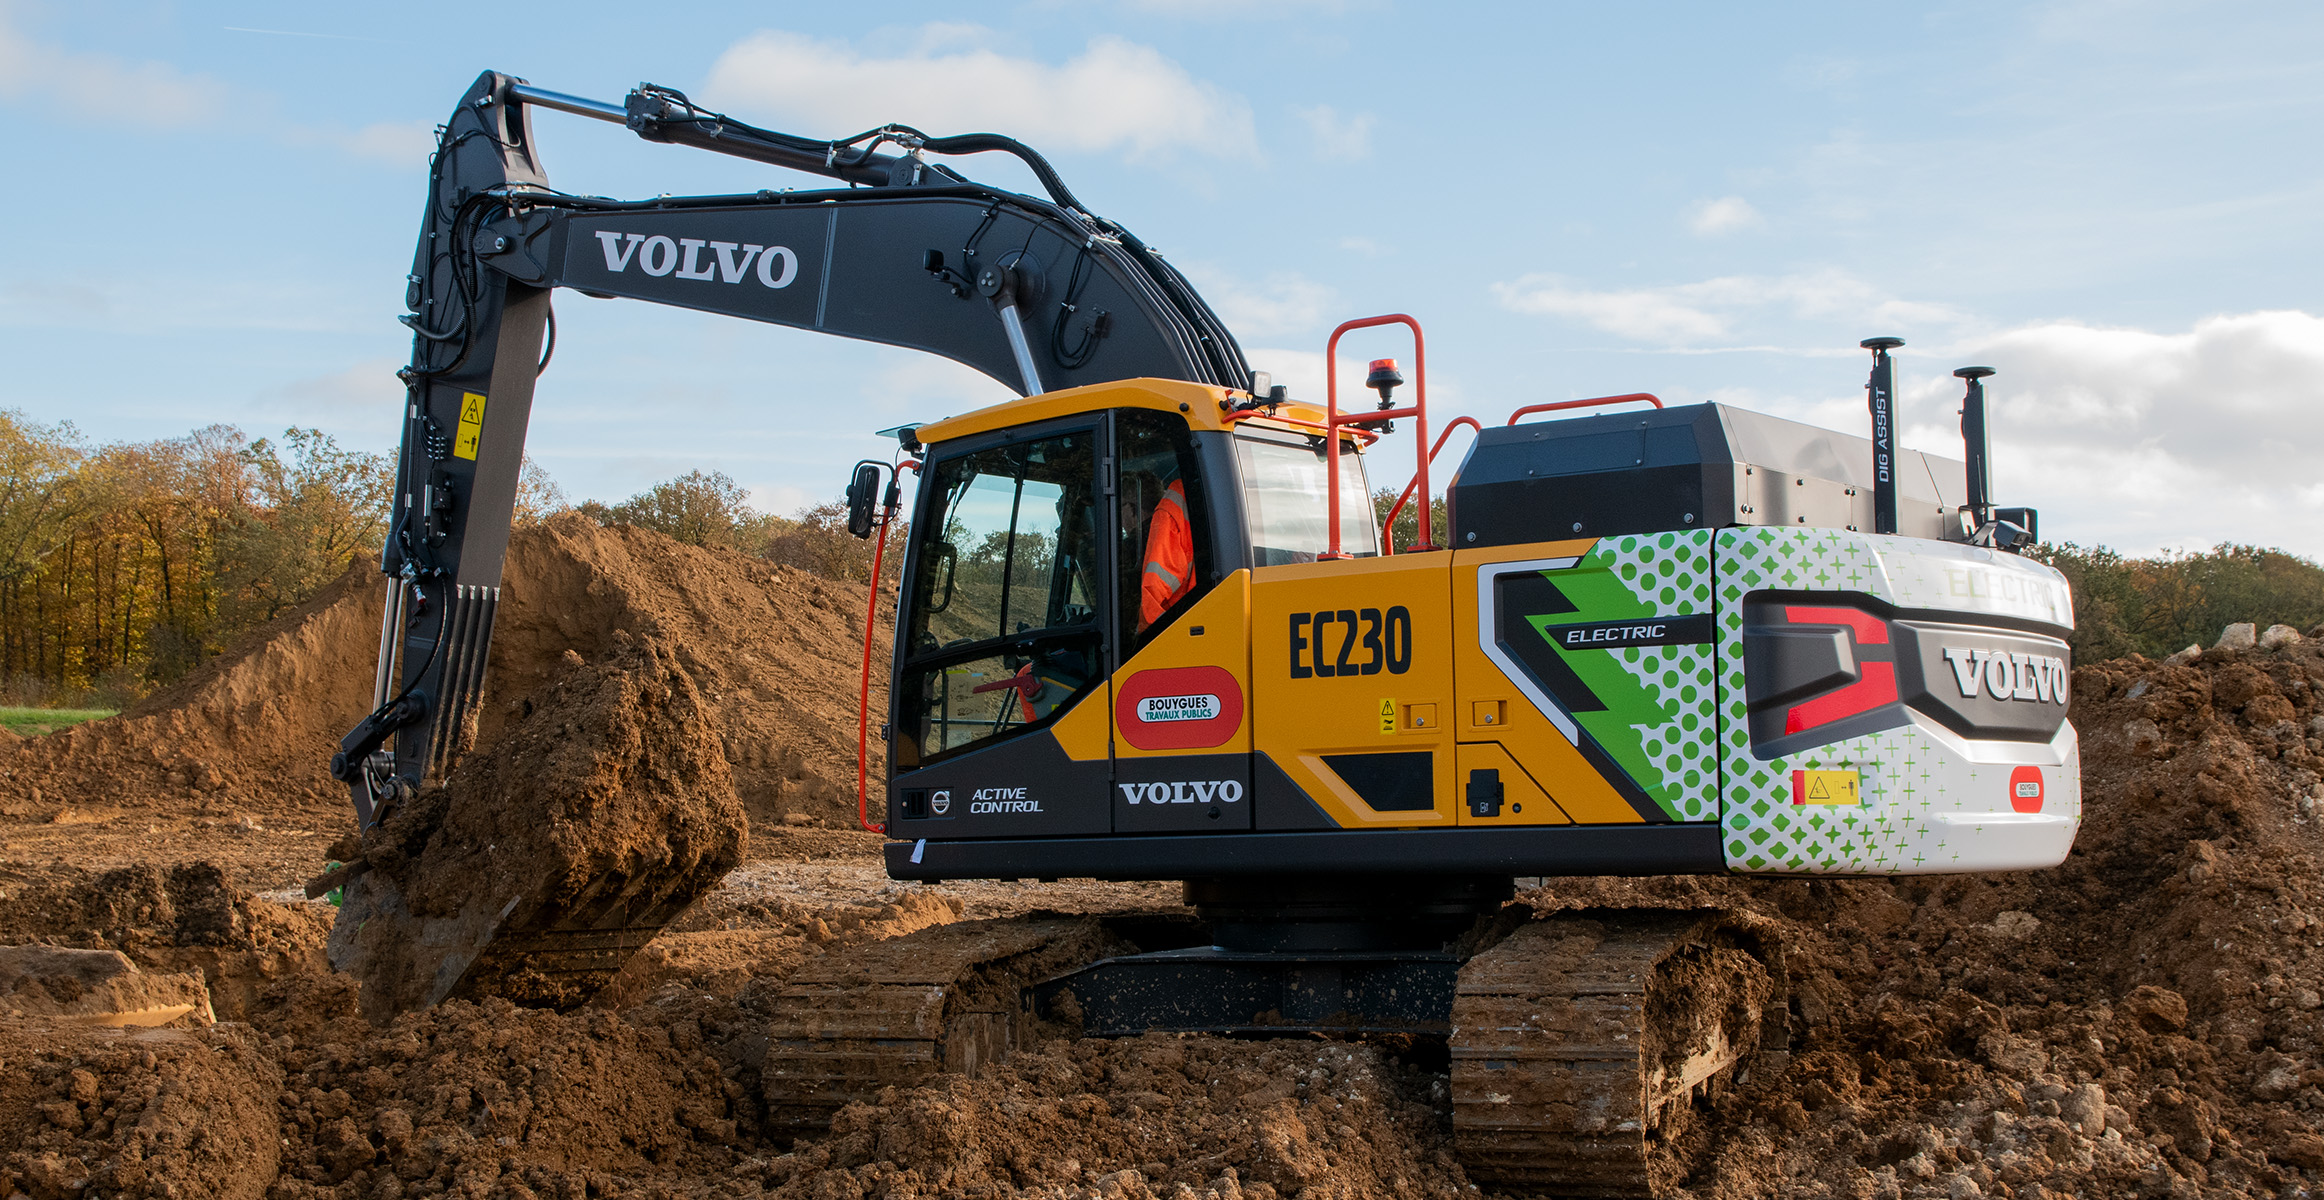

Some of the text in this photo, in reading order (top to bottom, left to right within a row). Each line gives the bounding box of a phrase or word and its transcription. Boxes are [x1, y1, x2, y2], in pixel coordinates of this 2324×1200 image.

[595, 230, 798, 289] VOLVO
[1875, 386, 1889, 483] DIG ASSIST
[1289, 605, 1412, 679] EC230
[1566, 624, 1666, 644] ELECTRIC
[1942, 647, 2068, 706] VOLVO
[1145, 708, 1212, 720] TRAVAUX PUBLICS
[1149, 696, 1208, 711] BOUYGUES
[972, 787, 1028, 800] ACTIVE
[1118, 779, 1243, 805] VOLVO
[970, 800, 1044, 814] CONTROL
